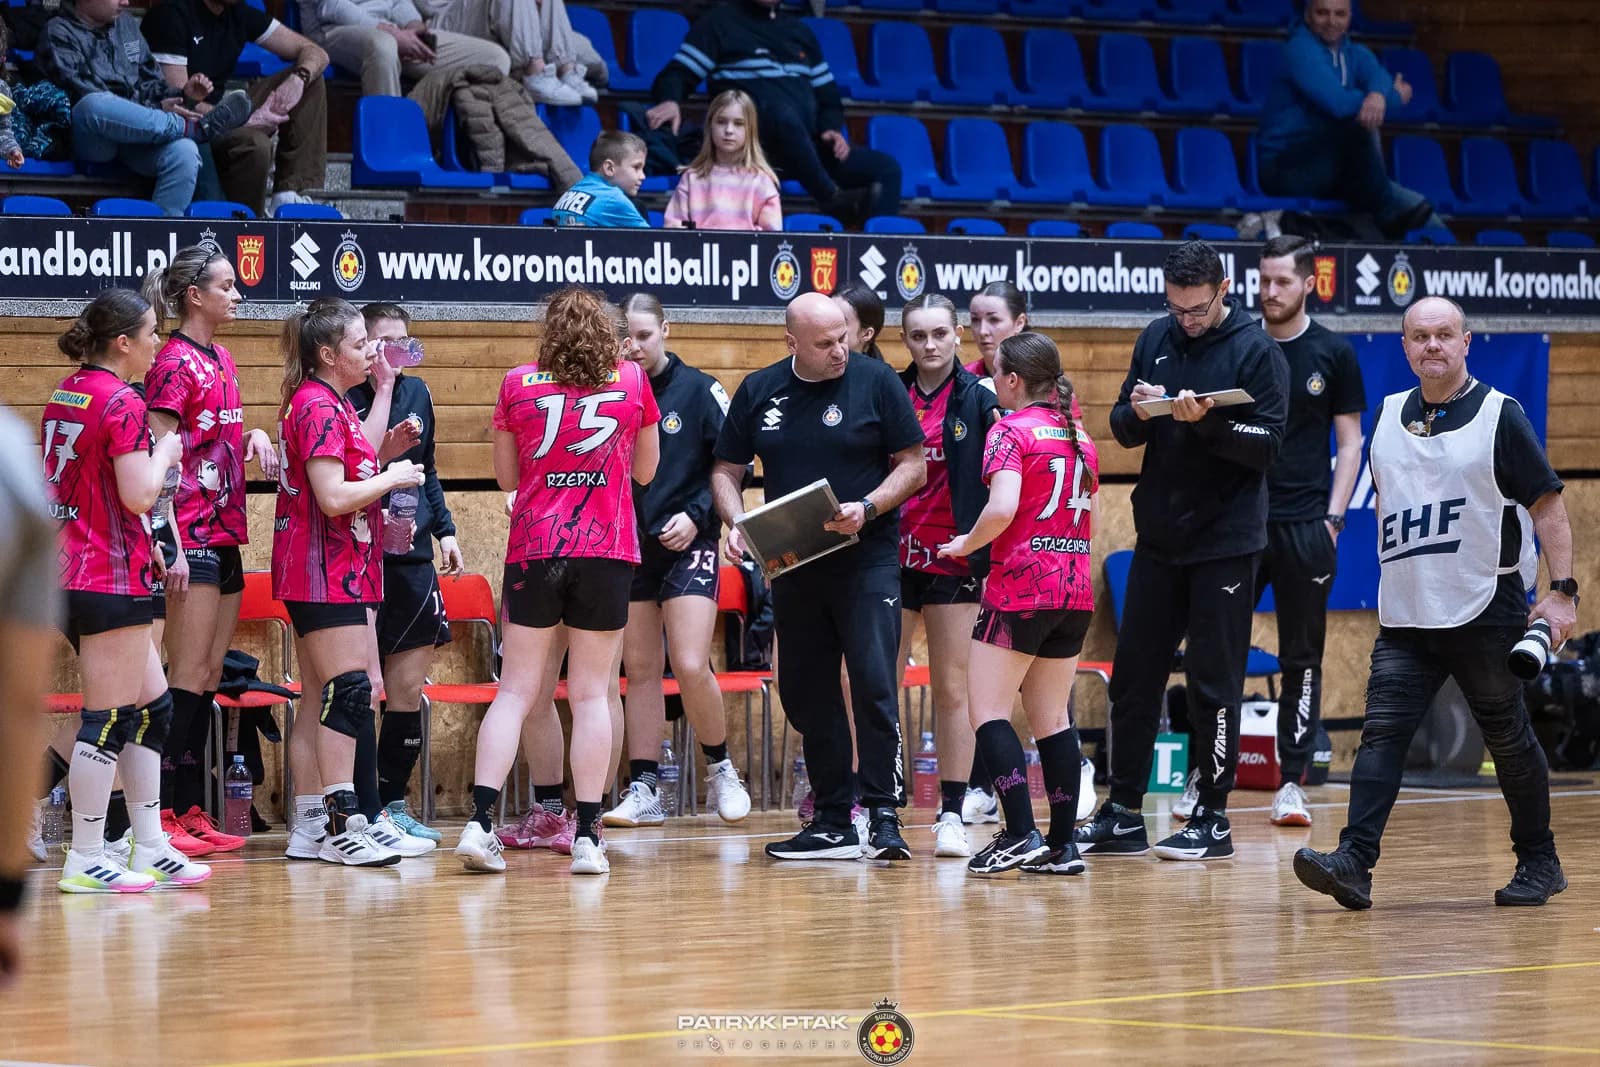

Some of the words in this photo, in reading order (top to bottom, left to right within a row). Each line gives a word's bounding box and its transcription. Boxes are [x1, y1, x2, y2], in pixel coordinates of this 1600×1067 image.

[240, 255, 260, 280] CK
[290, 281, 321, 290] SUZUKI
[378, 237, 759, 300] www.koronahandball.pl
[814, 267, 833, 291] CK
[43, 419, 85, 484] 17
[531, 391, 627, 459] 15
[547, 473, 607, 488] RZEPKA
[1036, 454, 1092, 528] 14
[1381, 496, 1466, 554] EHF
